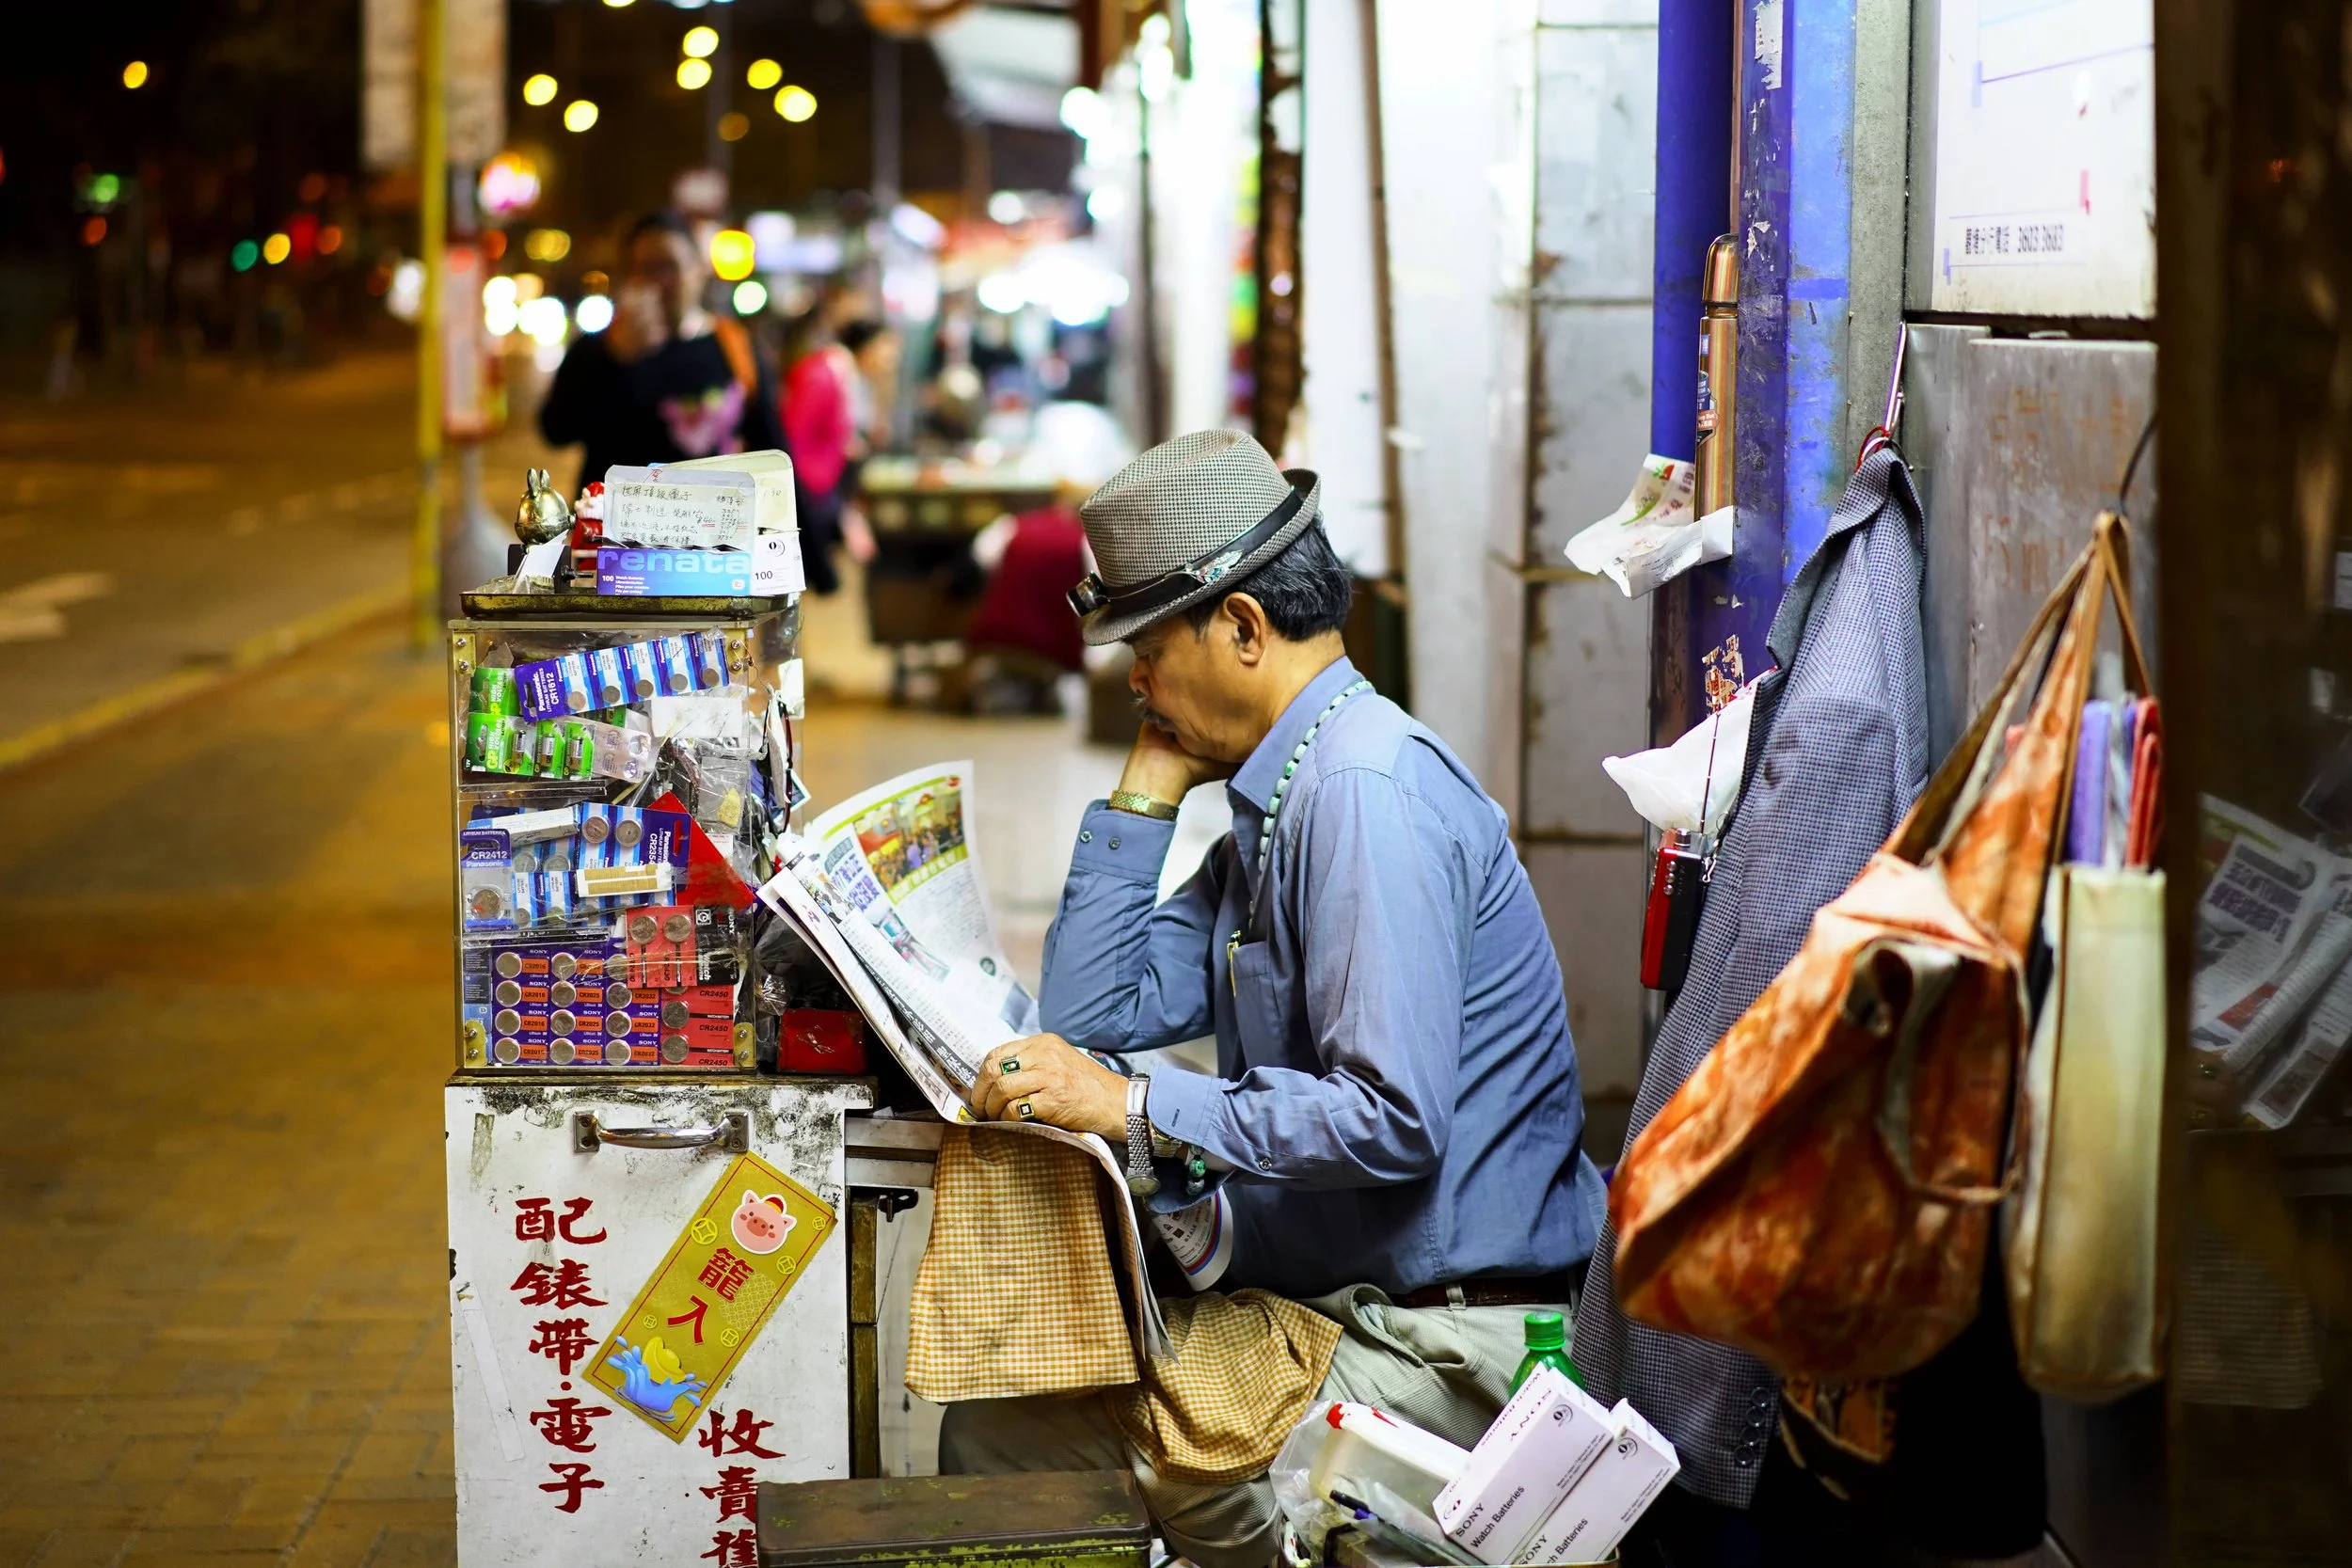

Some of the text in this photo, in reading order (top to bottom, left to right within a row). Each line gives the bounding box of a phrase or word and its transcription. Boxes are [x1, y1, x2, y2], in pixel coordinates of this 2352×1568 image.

[598, 549, 750, 575] renata
[755, 570, 772, 580] 100
[623, 648, 631, 670] Panasonic
[658, 641, 666, 663] Panasonic
[691, 635, 699, 657] Panasonic
[538, 668, 548, 694] BATTERIES
[555, 660, 564, 682] Panasonic
[496, 672, 504, 703] VOLTAGE
[533, 671, 547, 712] Panasonic
[546, 672, 560, 705] CR1612
[495, 718, 503, 750] VOLTAGE
[486, 750, 499, 769] GP
[471, 850, 508, 860] CR2412
[699, 990, 729, 998] CR2450
[698, 1058, 728, 1067] CR2450
[667, 1246, 755, 1345] 籠入
[1455, 1503, 1485, 1538] SONY
[1470, 1485, 1525, 1549] Watch Batteries
[1518, 1534, 1549, 1565] SONY
[1555, 1518, 1588, 1555] Batteries
